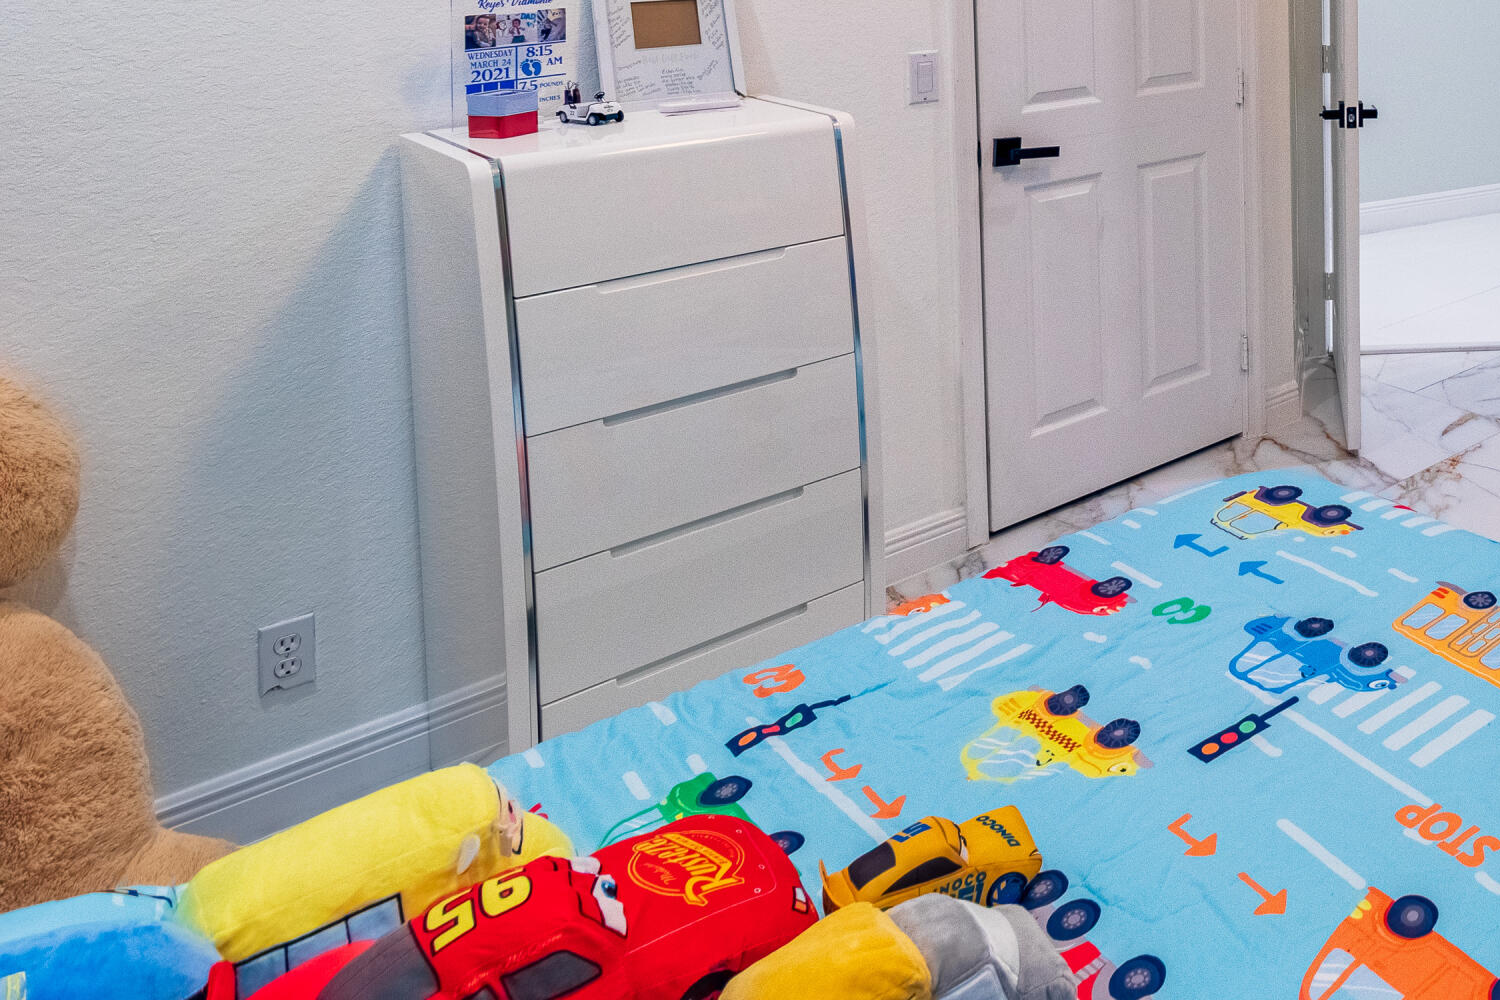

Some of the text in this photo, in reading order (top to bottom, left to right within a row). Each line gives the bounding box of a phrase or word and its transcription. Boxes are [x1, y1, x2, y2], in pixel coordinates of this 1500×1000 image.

[468, 49, 513, 60] WEDNESDAY
[526, 45, 553, 58] 8:15
[470, 58, 512, 70] MARCH 24
[546, 56, 563, 66] AM
[471, 67, 511, 83] 2021
[519, 80, 538, 91] 7.5
[976, 815, 1022, 847] DINOCO
